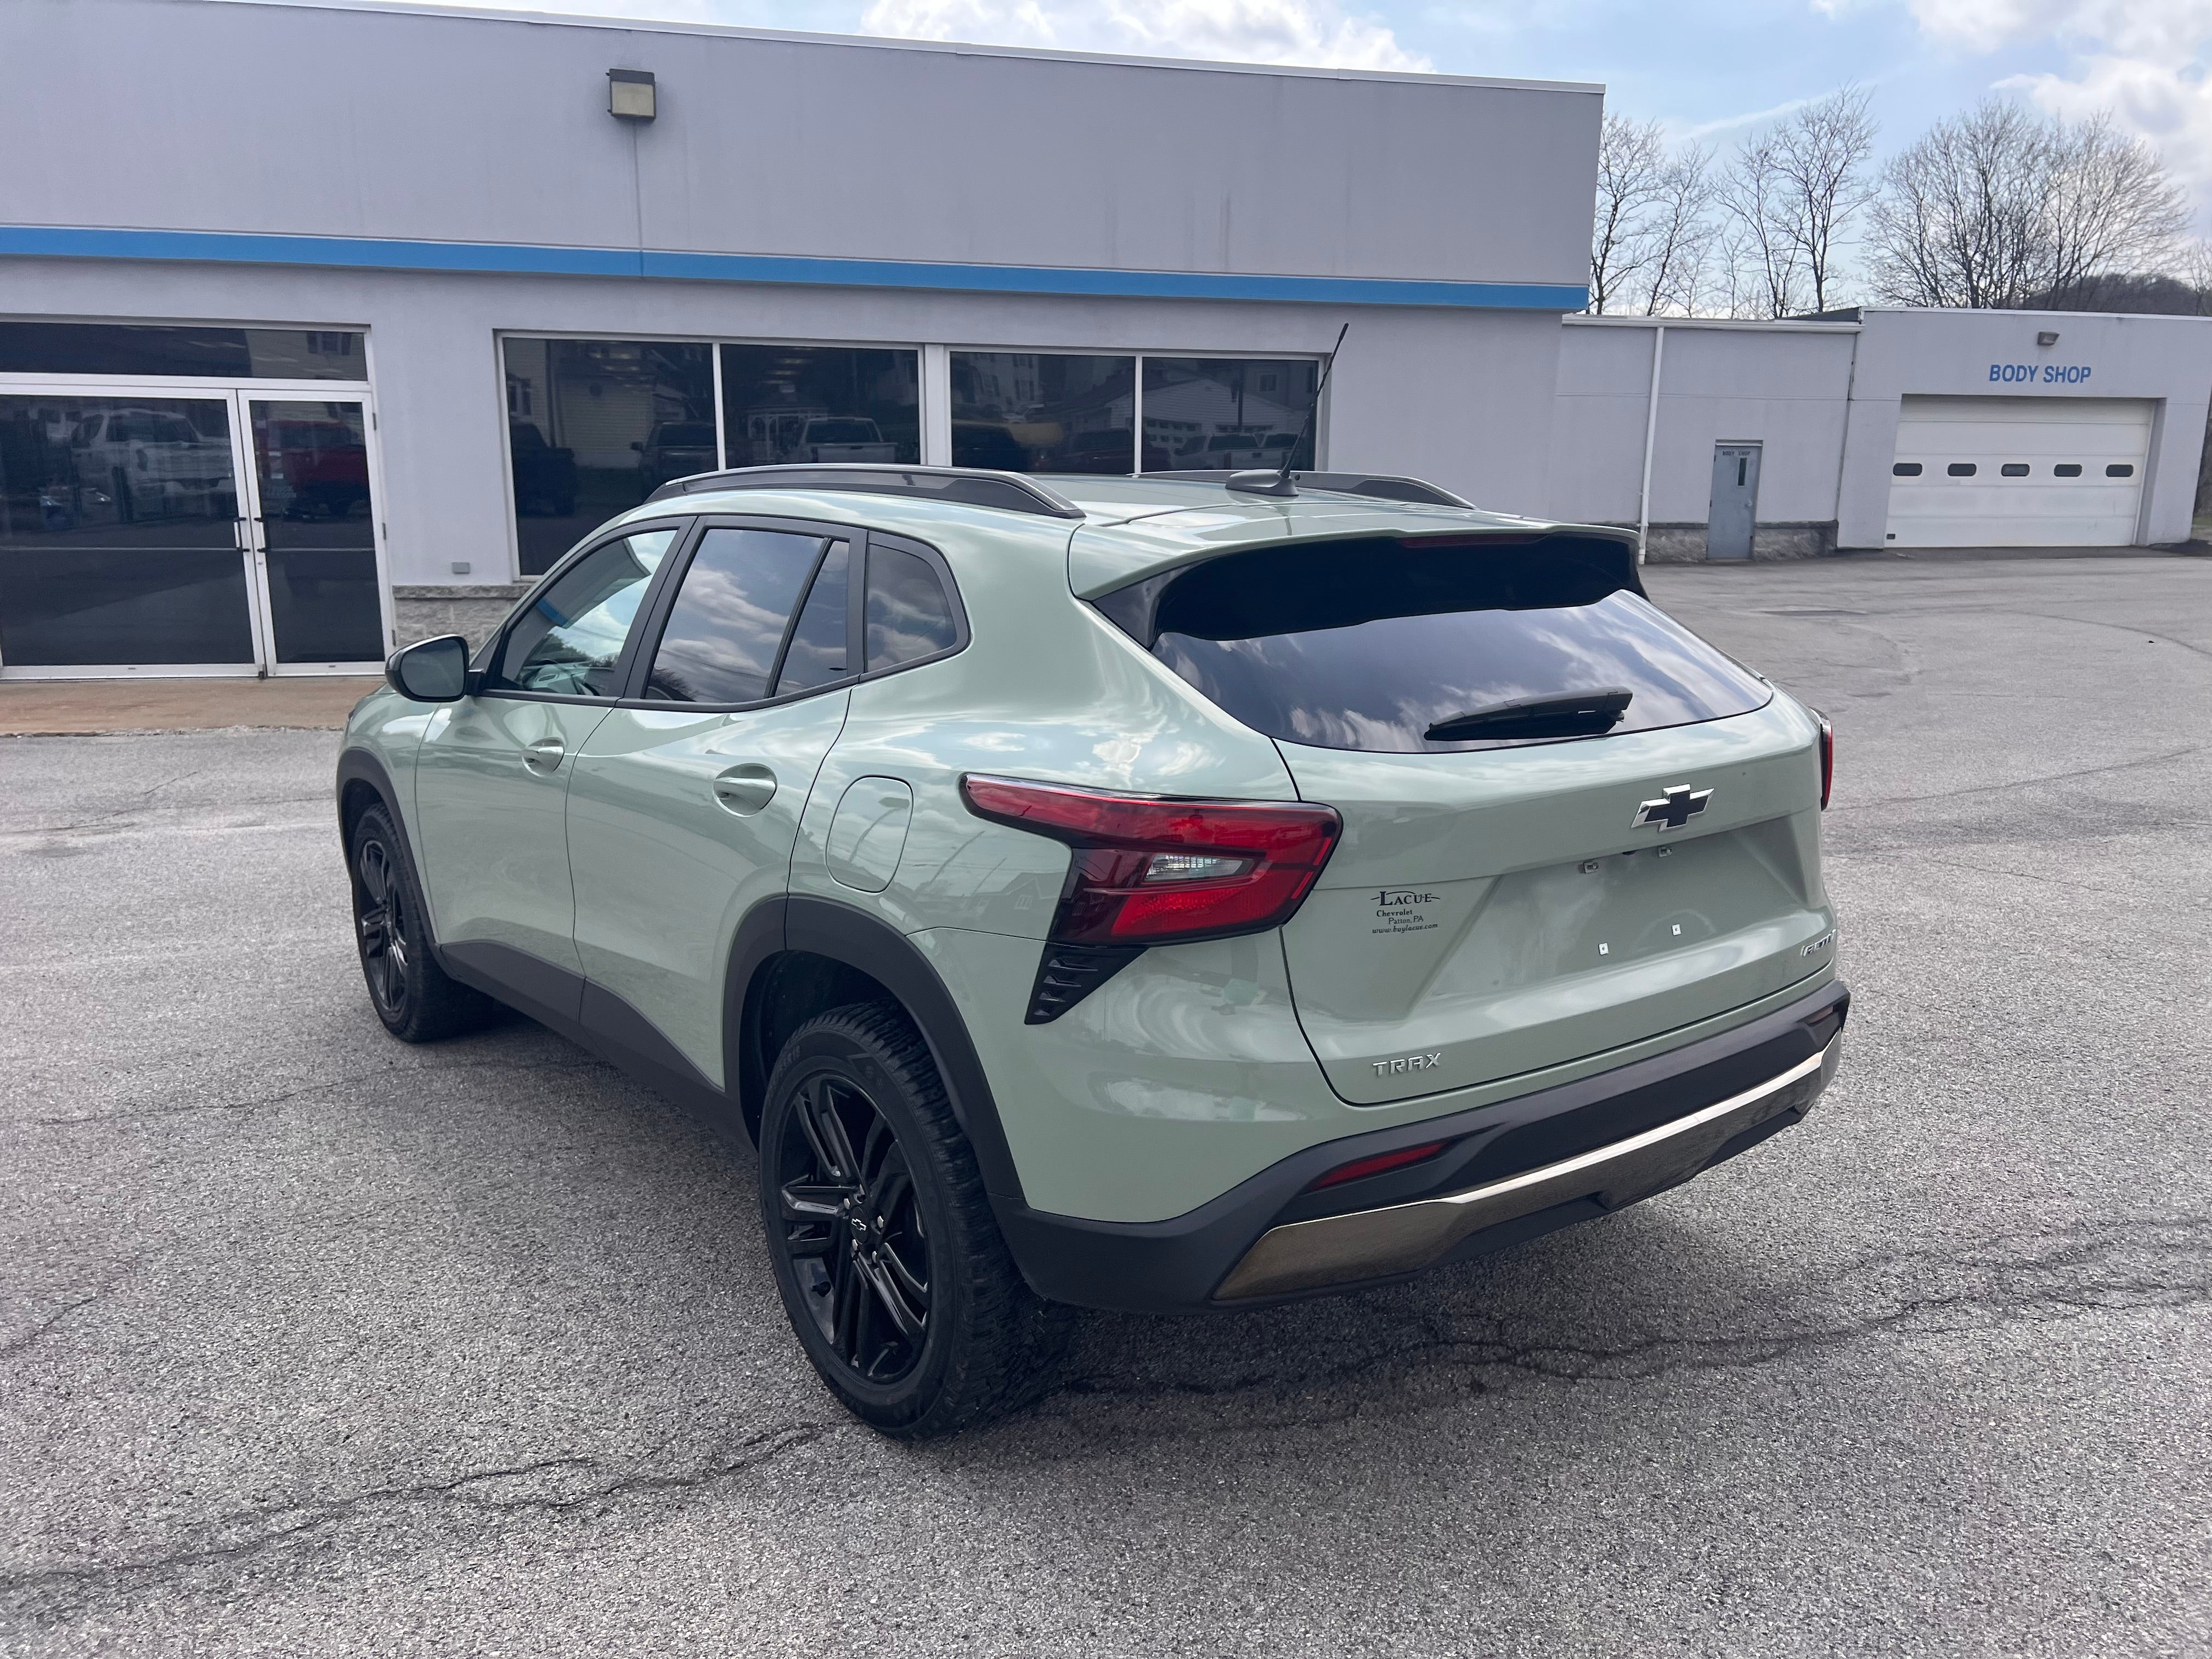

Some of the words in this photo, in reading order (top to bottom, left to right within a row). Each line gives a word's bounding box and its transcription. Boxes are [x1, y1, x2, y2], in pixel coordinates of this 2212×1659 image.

[1989, 364, 2039, 382] BODY
[2043, 365, 2091, 383] SHOP
[1376, 909, 1413, 917] Chevrolet
[1372, 923, 1438, 934] www.buylacue.com
[1373, 1052, 1442, 1076] TRAX
